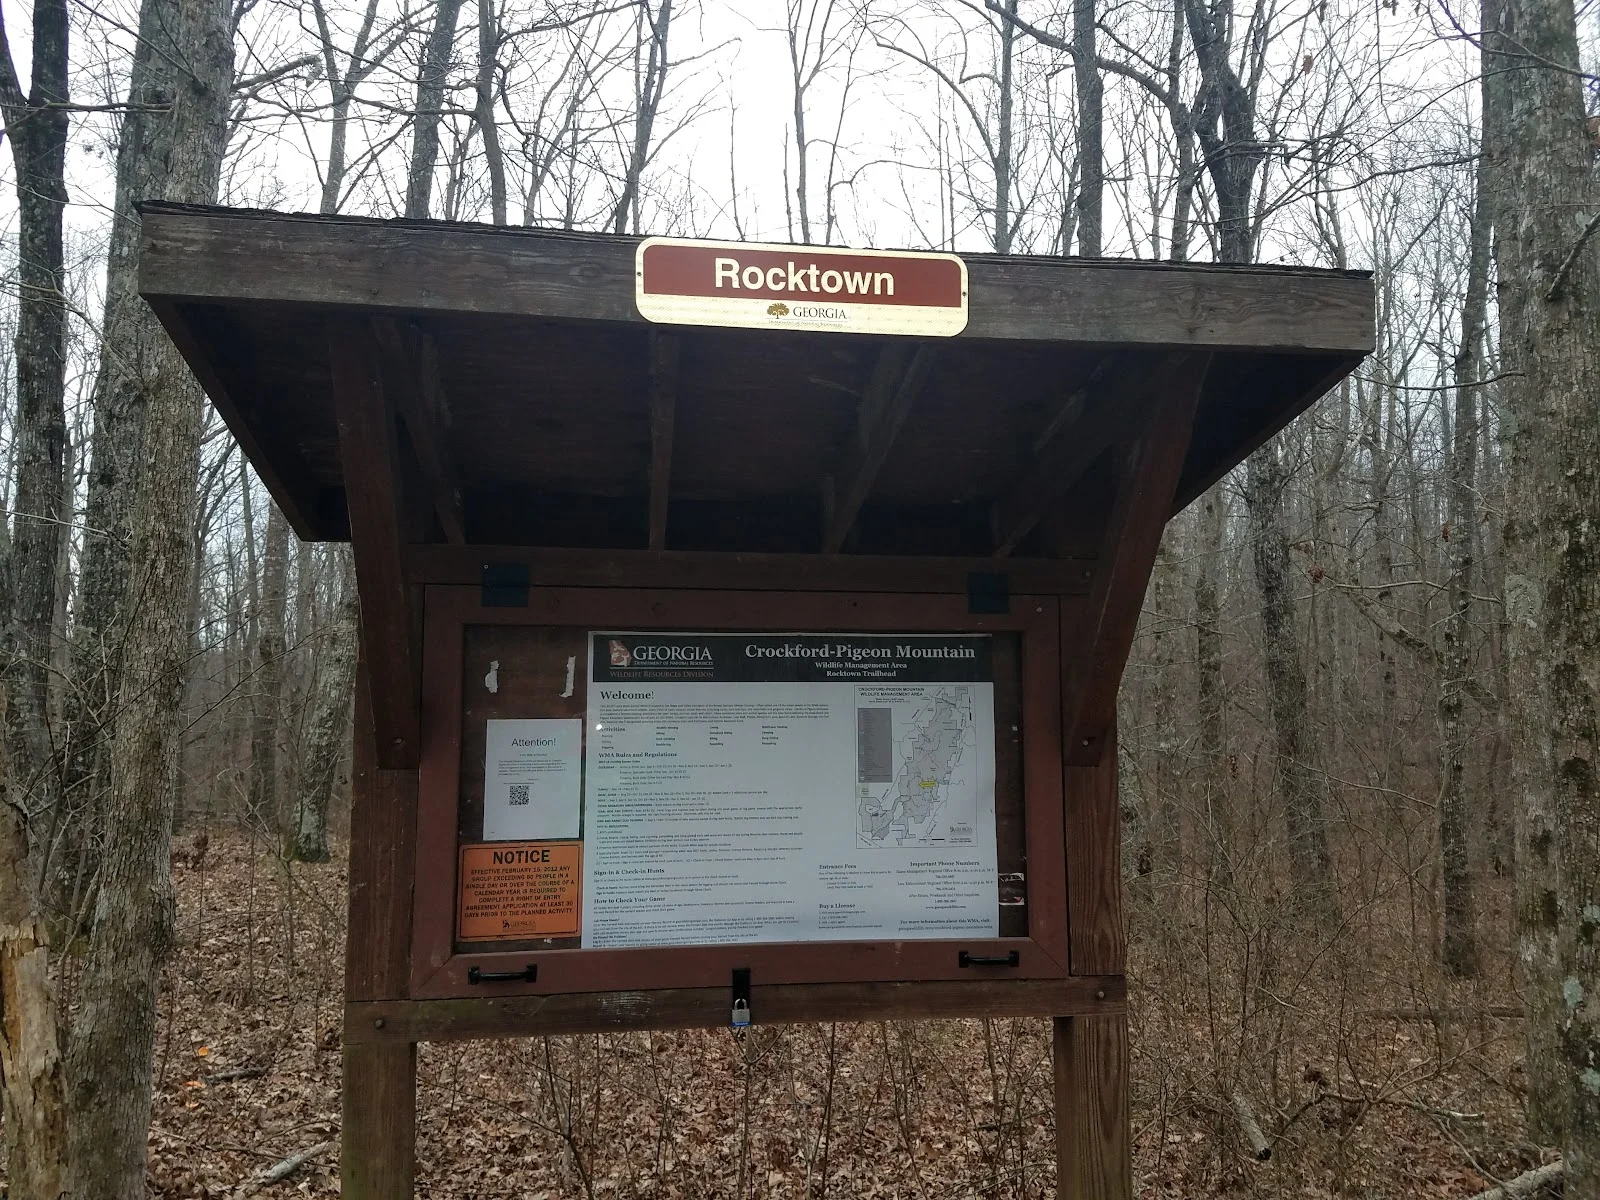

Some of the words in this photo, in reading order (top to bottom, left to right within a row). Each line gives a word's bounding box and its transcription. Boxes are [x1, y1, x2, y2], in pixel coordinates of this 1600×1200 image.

[715, 257, 894, 296] Rocktown
[793, 306, 847, 320] GEORGIA
[633, 645, 713, 661] GEORGIA
[745, 643, 892, 661] Crockford-Pigeon
[896, 645, 976, 658] Mountain
[844, 662, 890, 670] Management
[600, 690, 654, 700] Welcome!
[511, 738, 556, 747] Attention!
[493, 849, 551, 865] NOTICE
